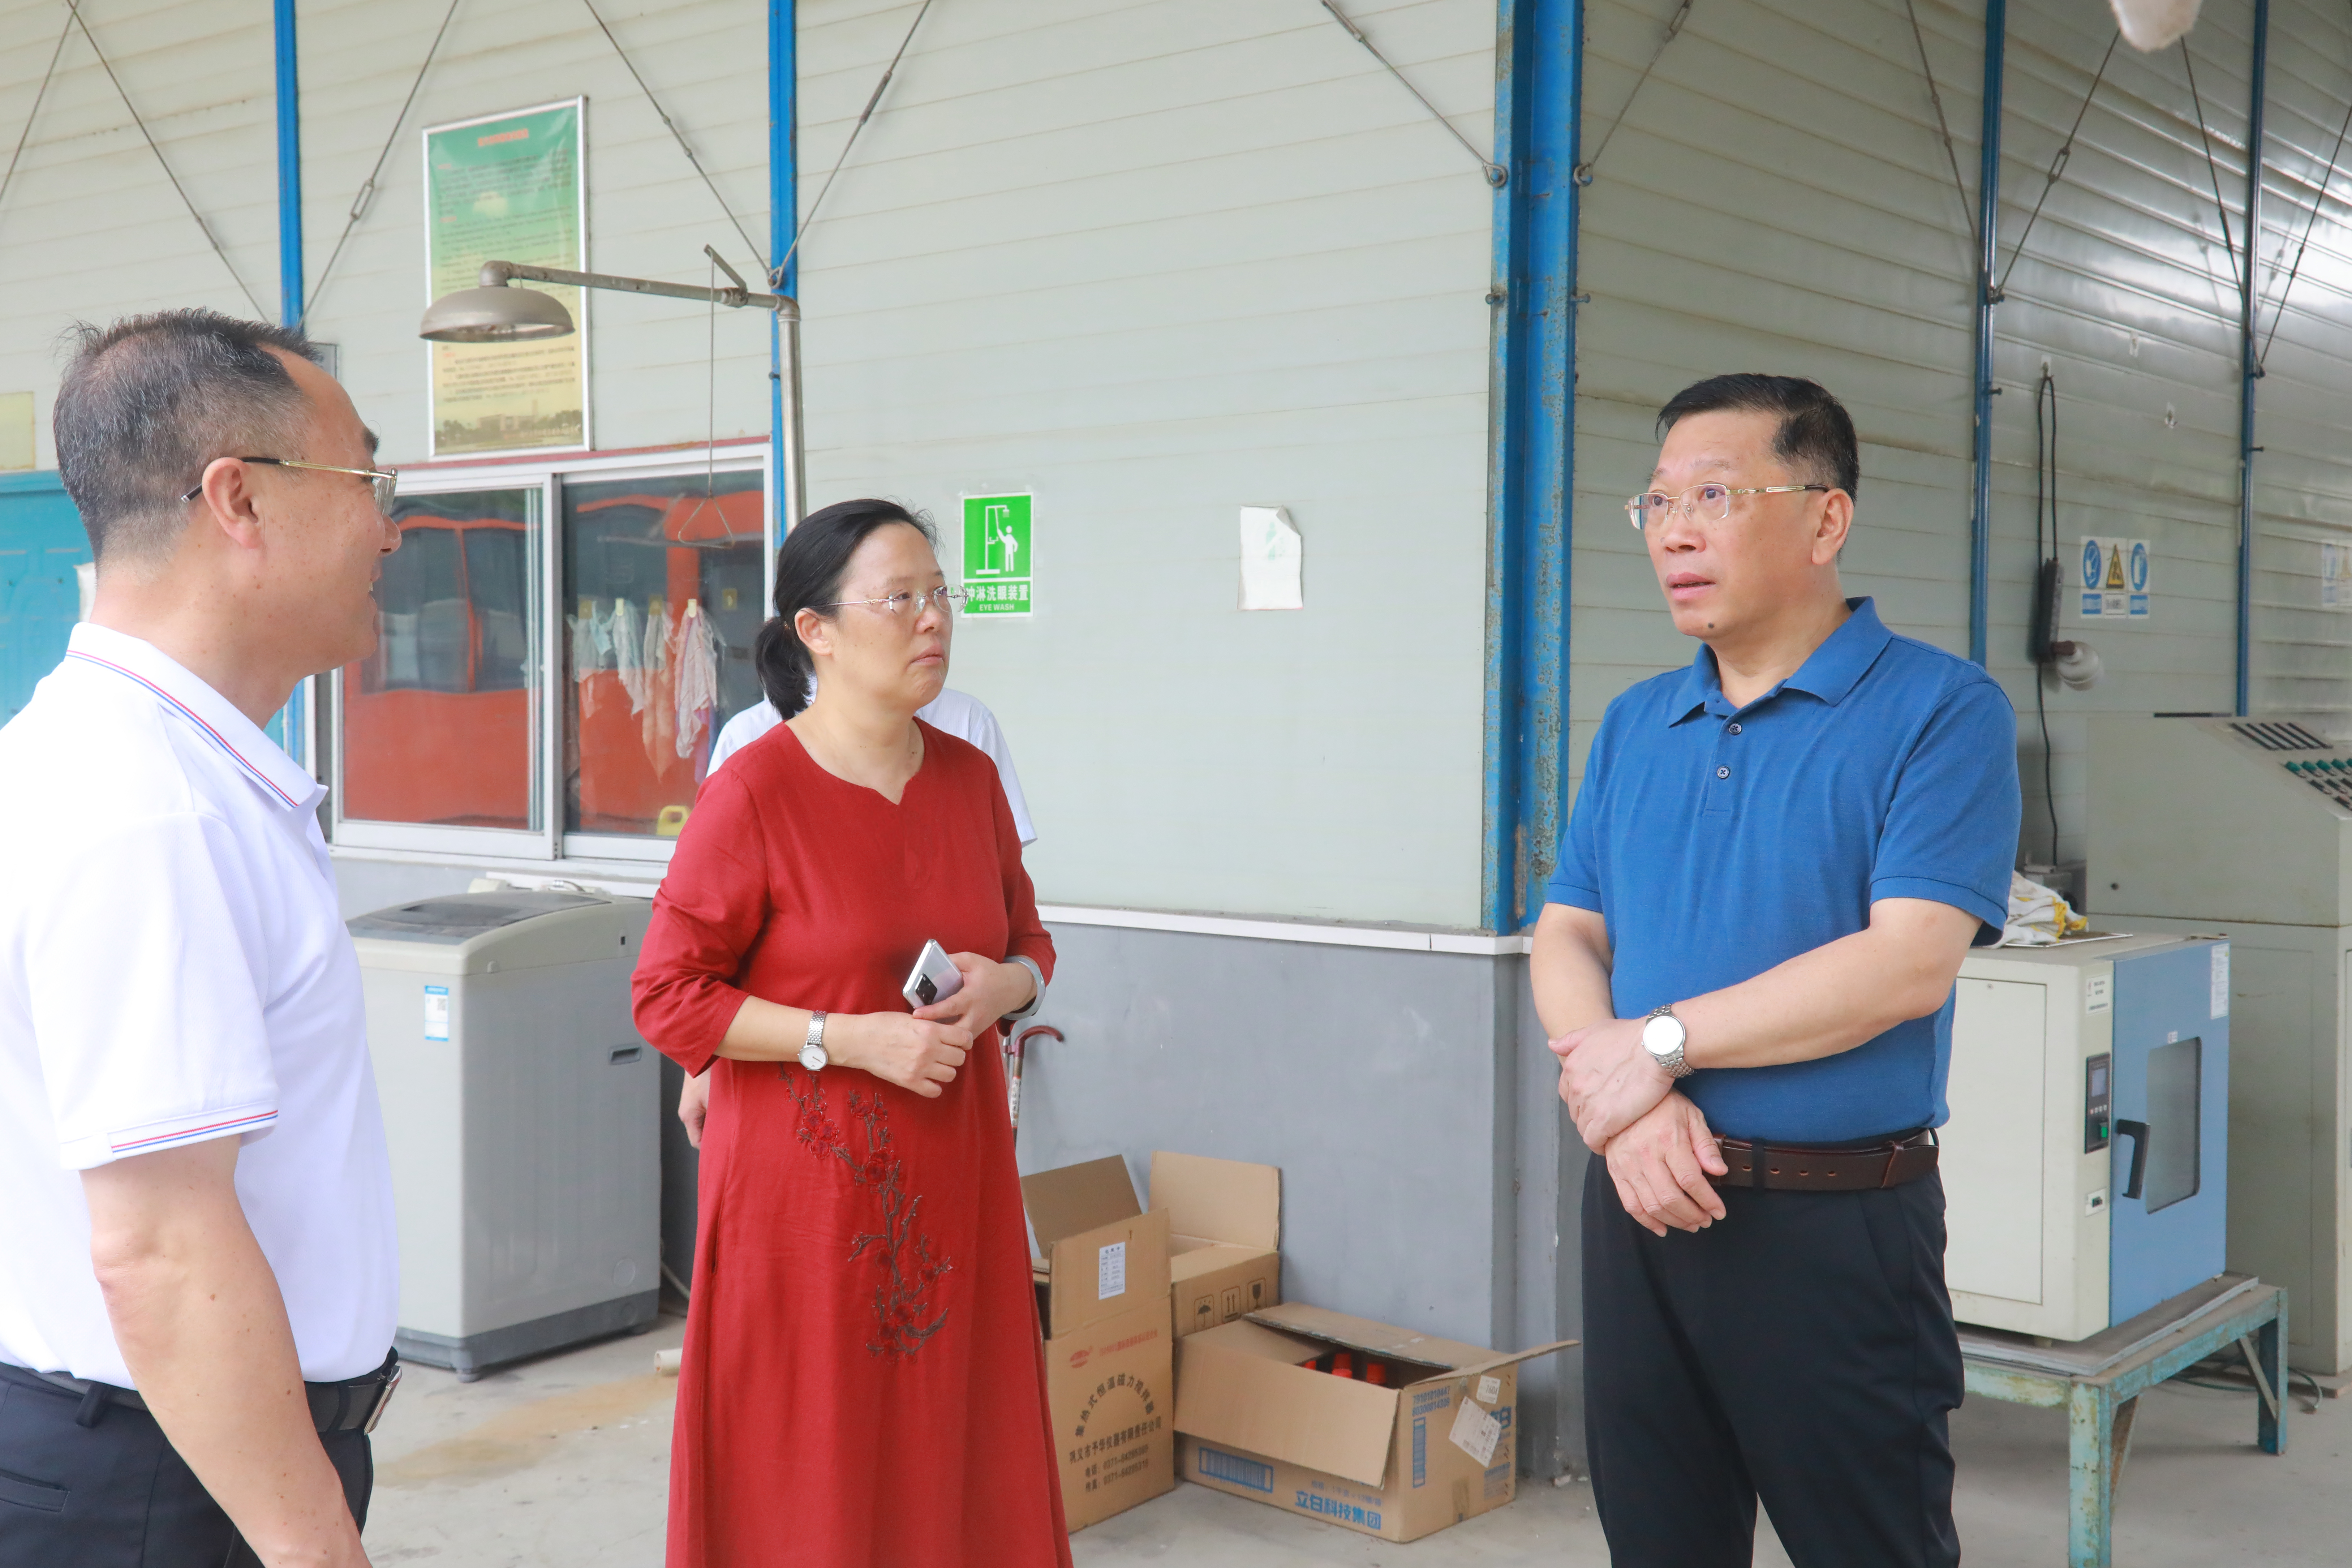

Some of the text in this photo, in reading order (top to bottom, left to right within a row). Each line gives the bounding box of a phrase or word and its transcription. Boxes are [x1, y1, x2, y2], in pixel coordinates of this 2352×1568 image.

[966, 584, 1028, 602] 冲淋洗眼装置
[1295, 1490, 1381, 1530] 立白科技集团
